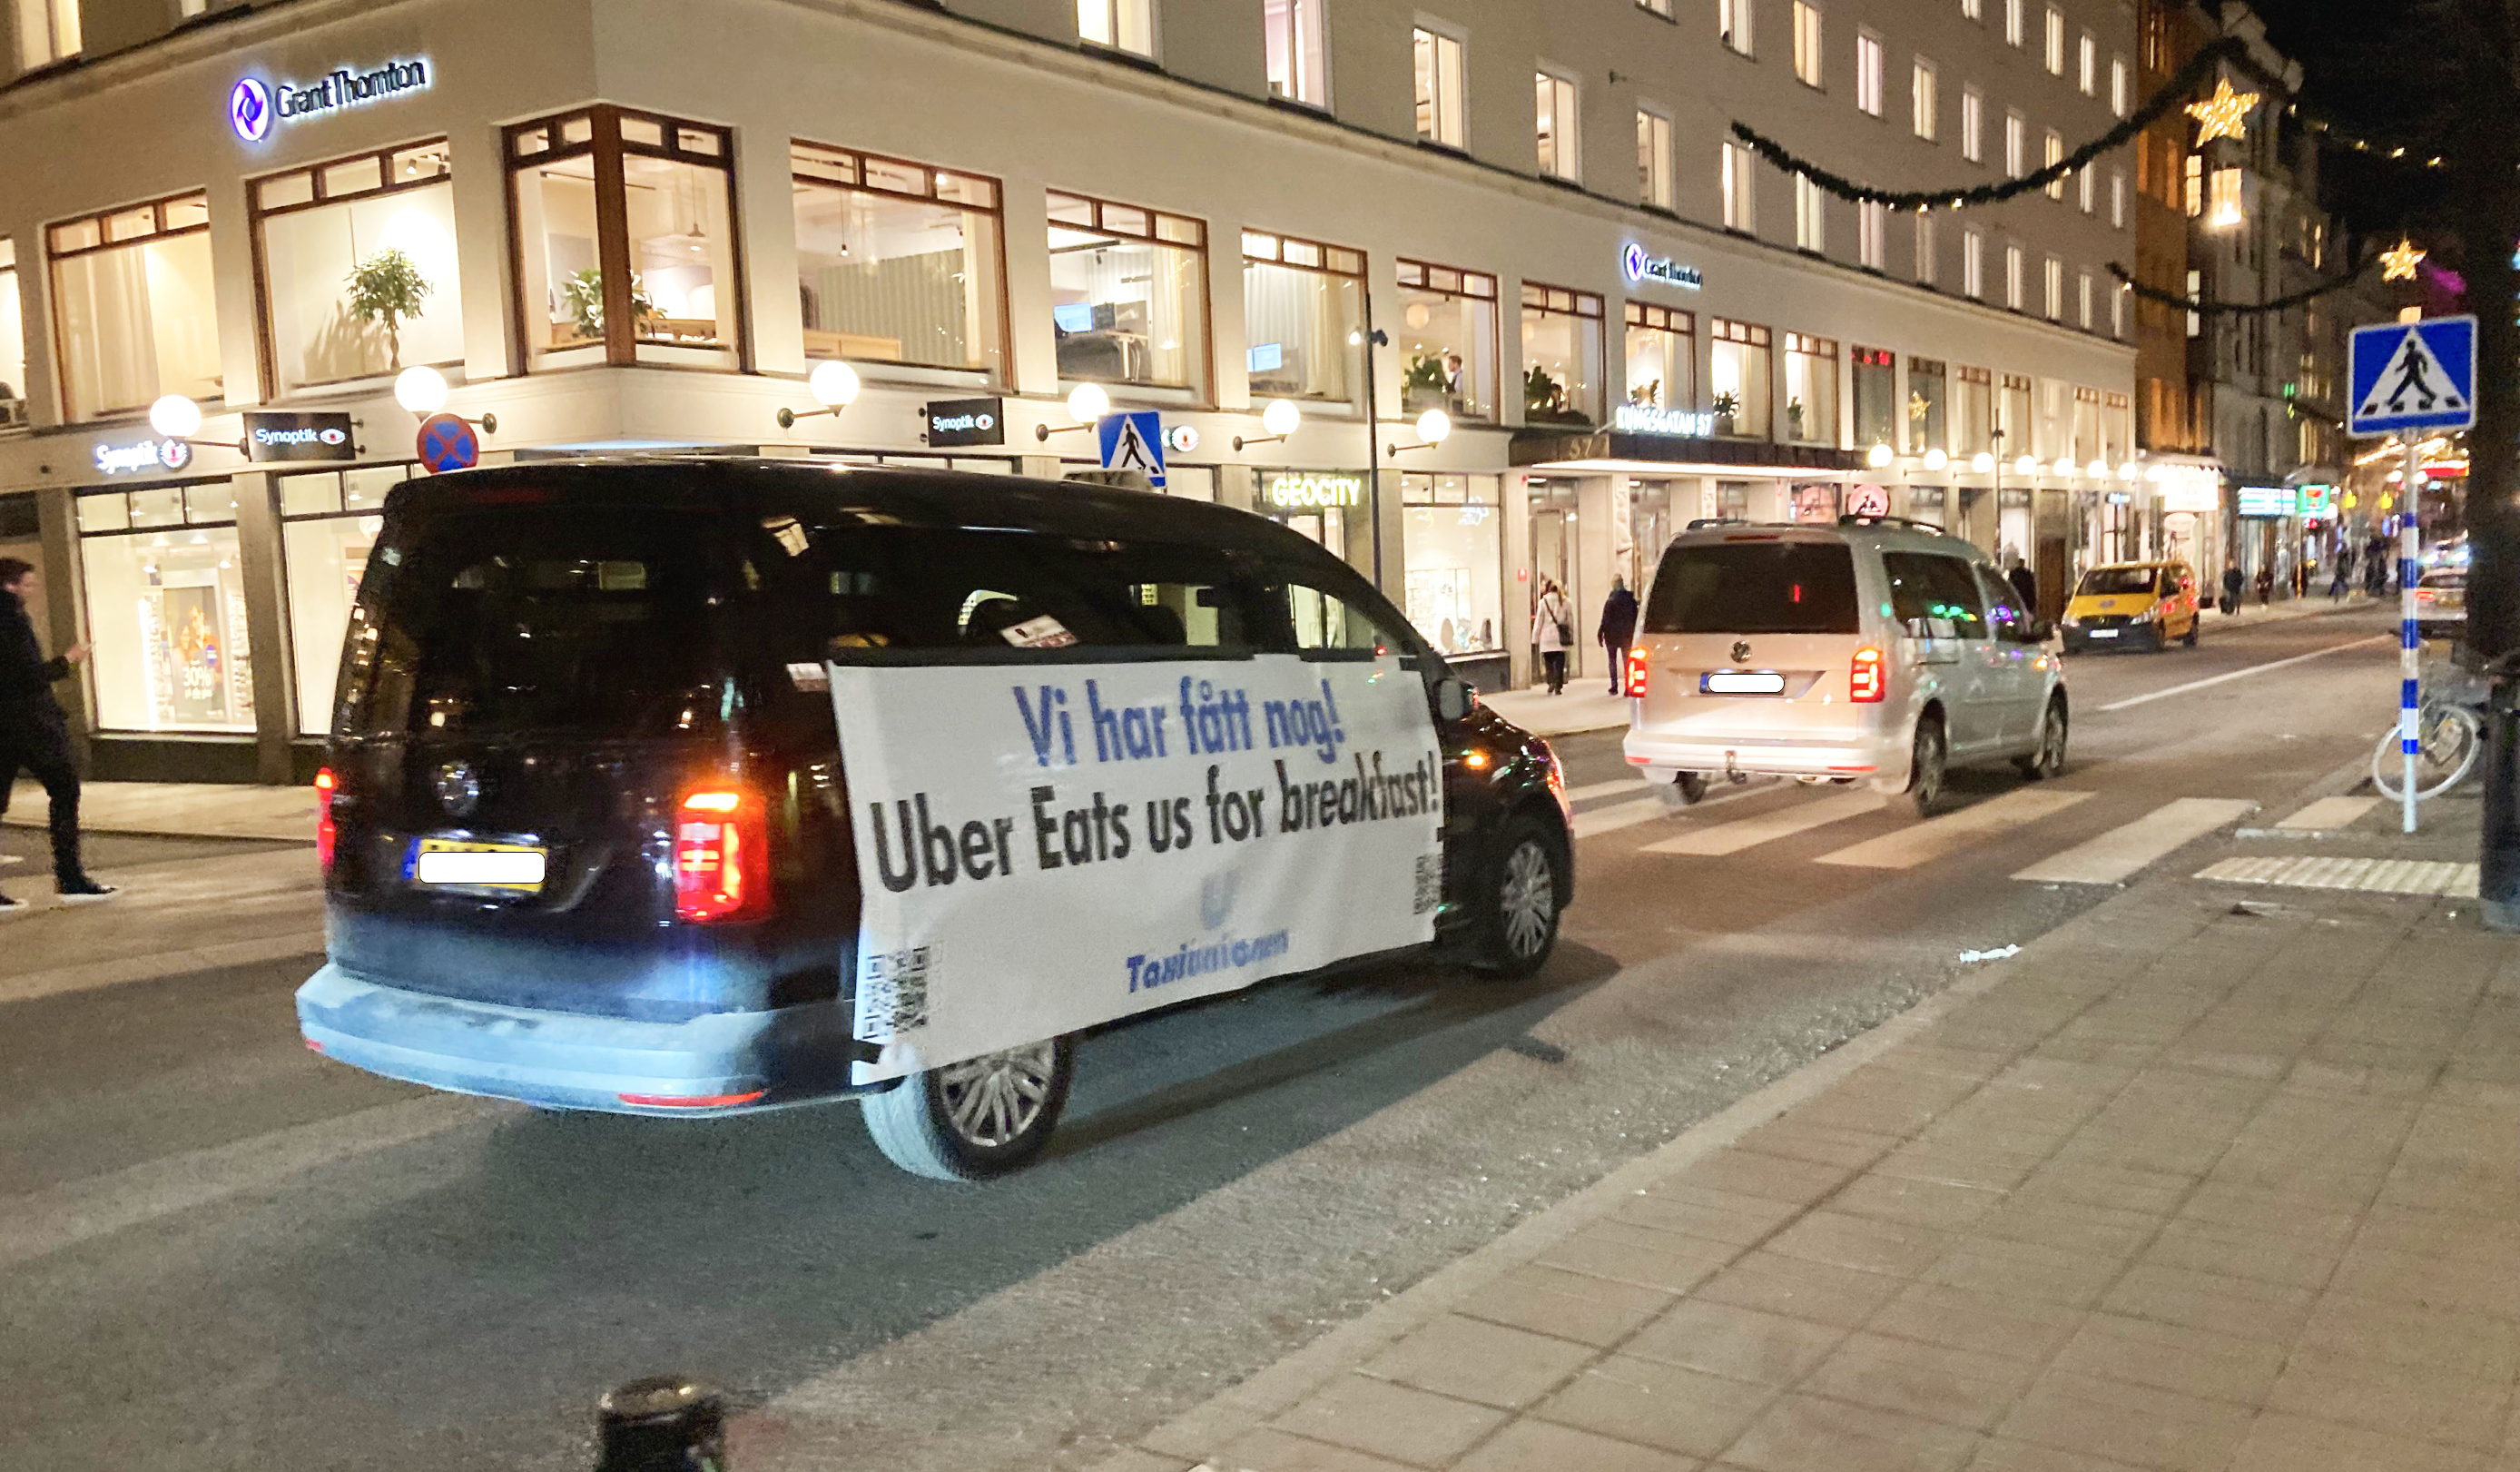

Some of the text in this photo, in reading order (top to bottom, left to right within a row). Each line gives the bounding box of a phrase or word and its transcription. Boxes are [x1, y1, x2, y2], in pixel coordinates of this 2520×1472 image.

[275, 62, 426, 118] Grant Thornton
[254, 428, 319, 446] Synoptik
[932, 414, 975, 432] Synoptik
[1271, 477, 1361, 507] GEOCITY
[1012, 675, 1346, 766] Vi har fått nog!
[870, 750, 1439, 893] Uber Eats us for breakfast!
